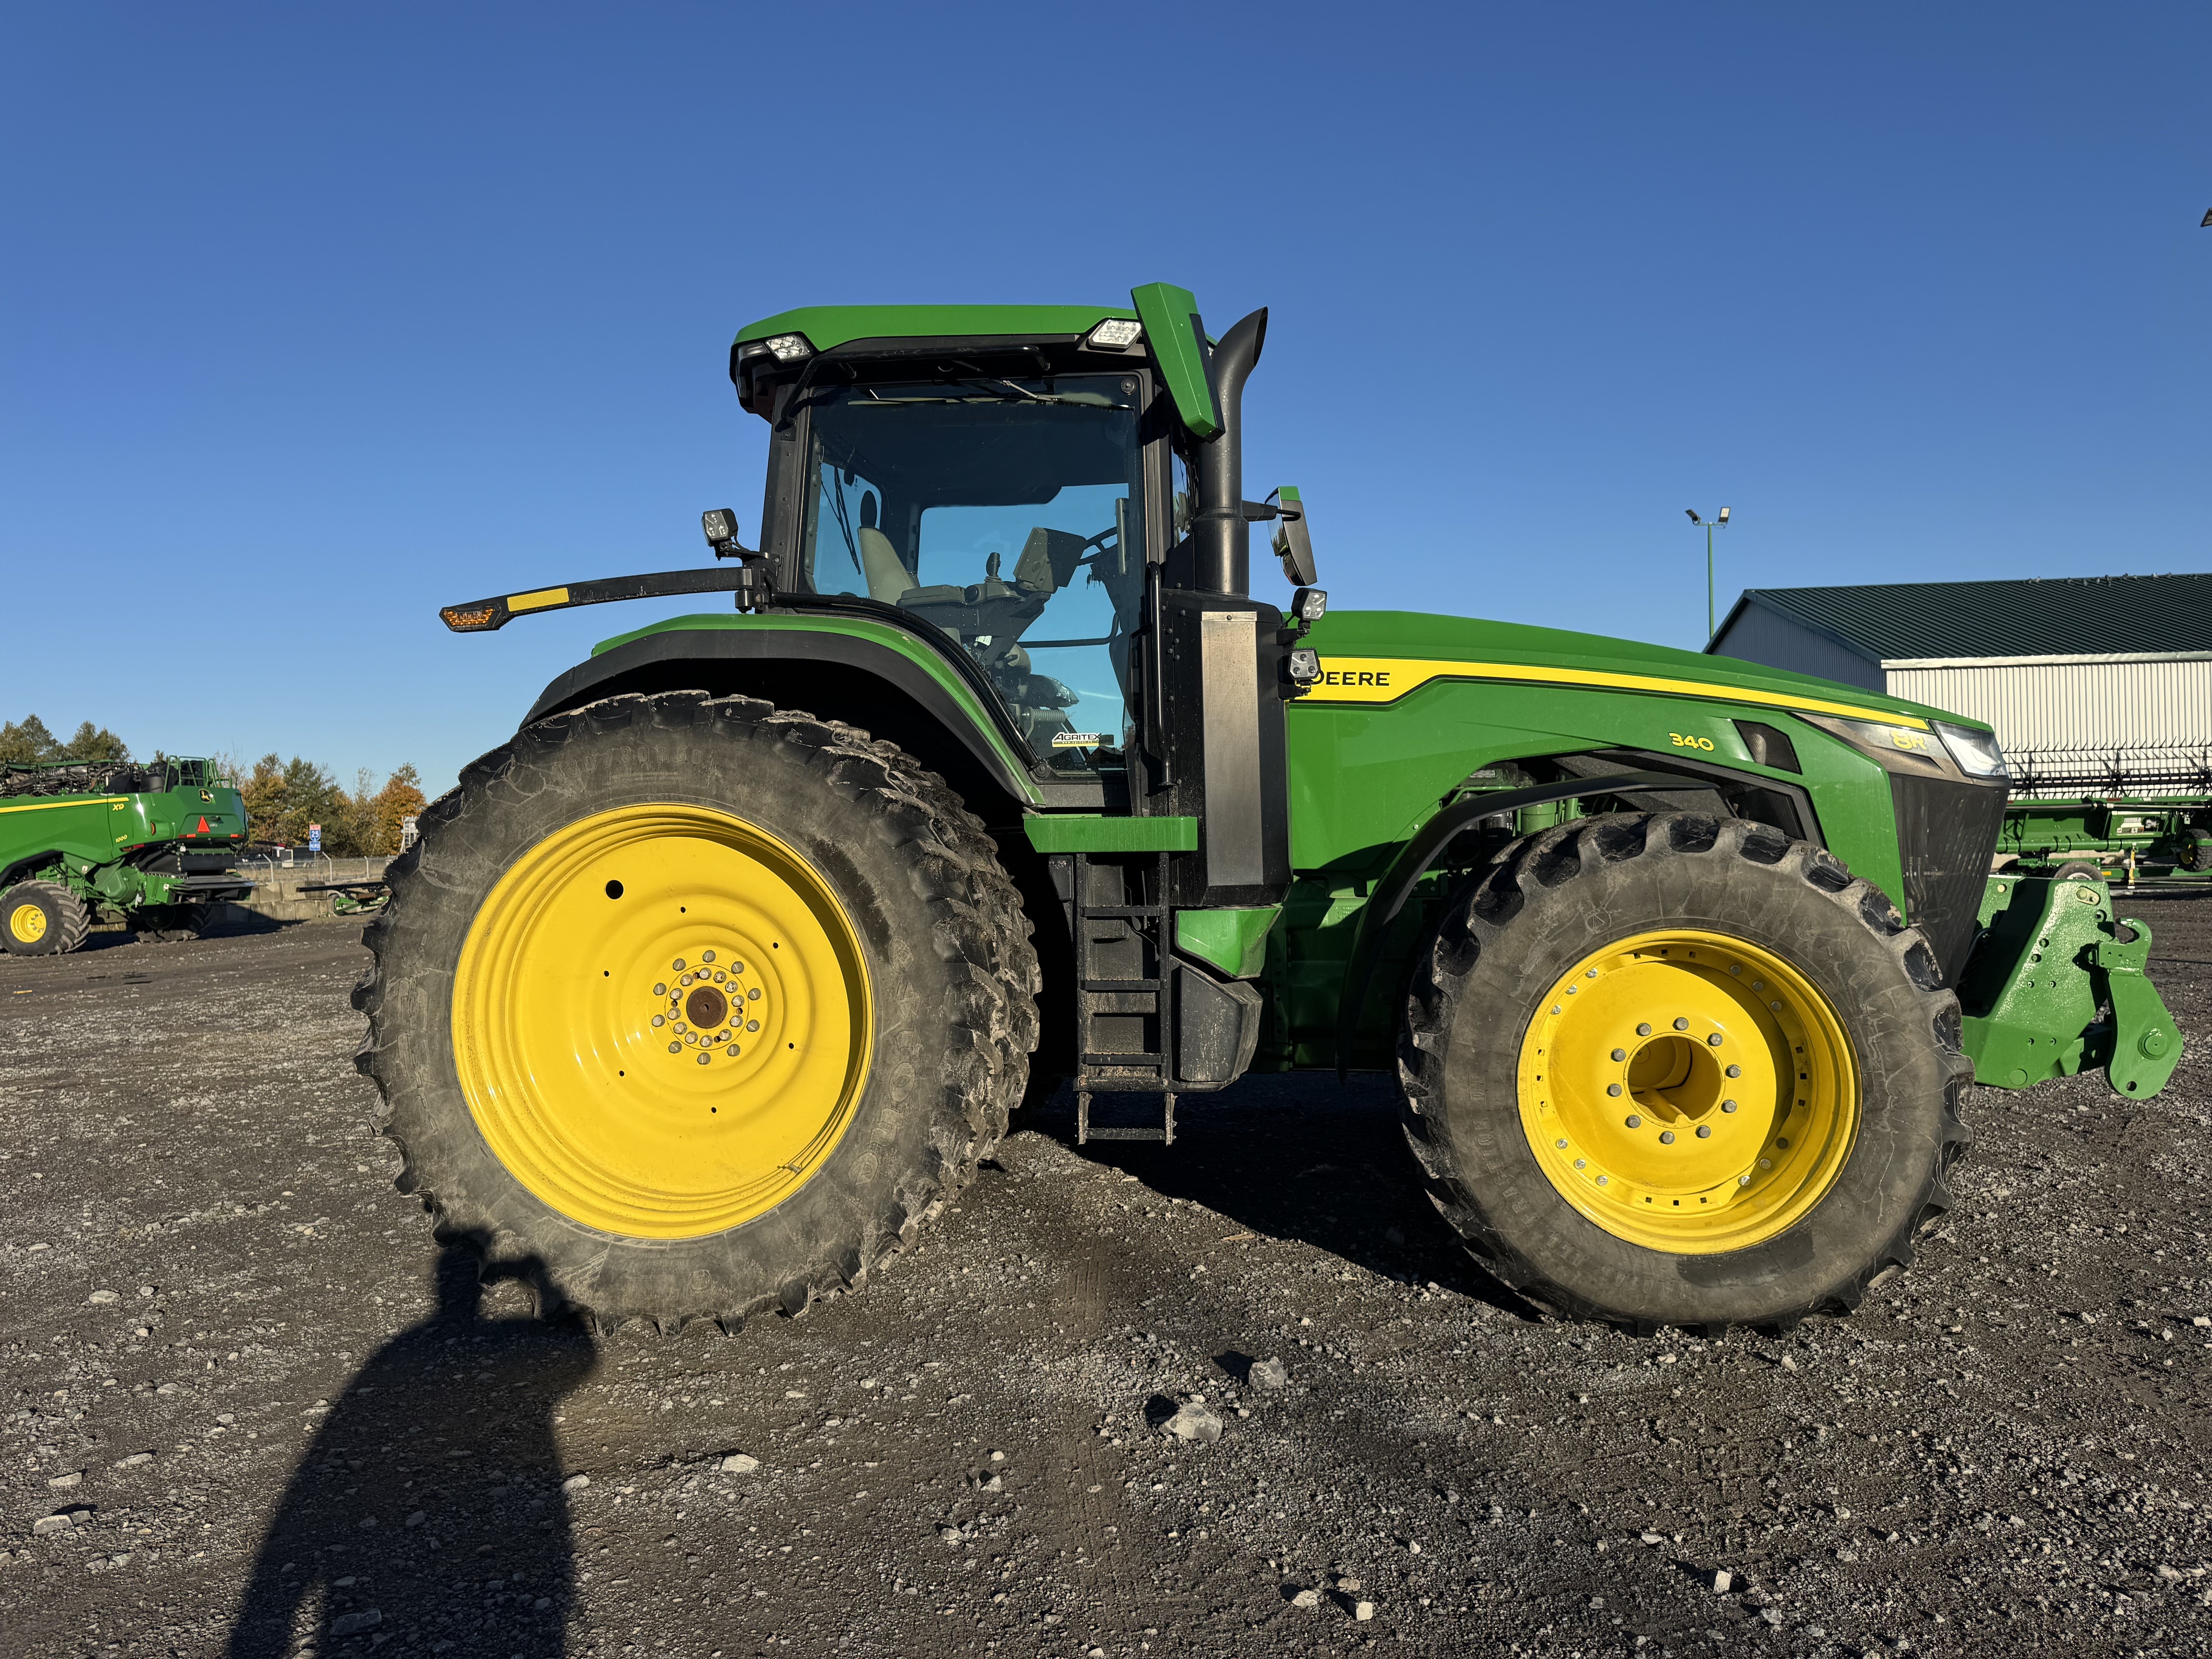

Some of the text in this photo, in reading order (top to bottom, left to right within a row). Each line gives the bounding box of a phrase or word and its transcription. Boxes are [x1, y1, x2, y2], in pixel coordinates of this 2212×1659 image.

[1669, 732, 1714, 751] 340
[1890, 730, 1927, 750] 8R
[115, 834, 127, 843] 1000
[1467, 1073, 1487, 1102] DT
